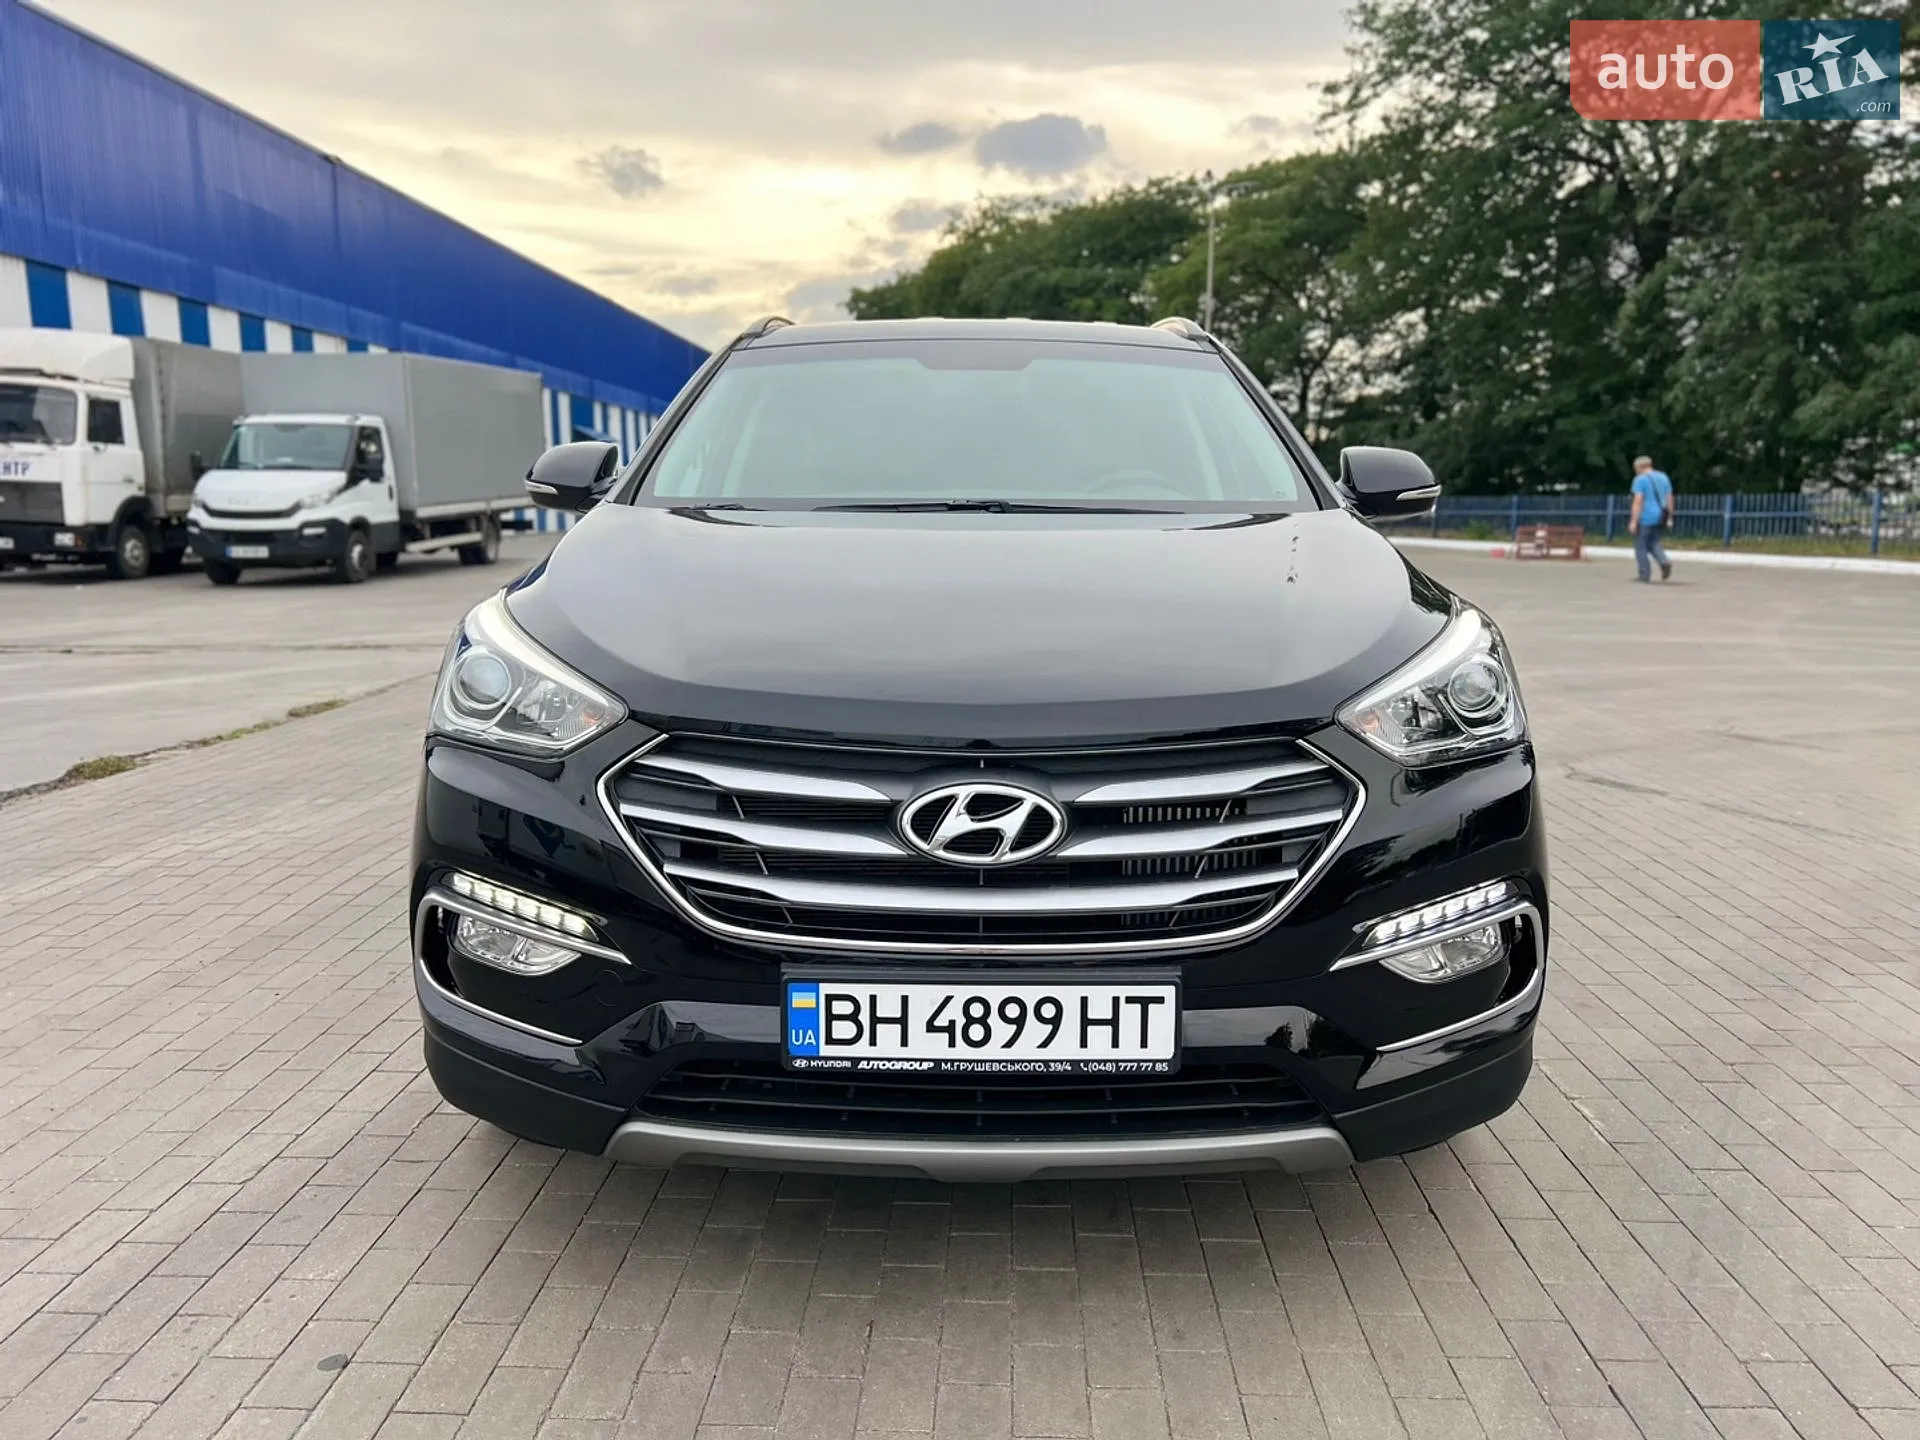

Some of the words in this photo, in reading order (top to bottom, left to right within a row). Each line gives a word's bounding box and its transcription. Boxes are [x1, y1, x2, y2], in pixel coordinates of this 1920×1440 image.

[825, 994, 908, 1047] BH
[926, 995, 1063, 1049] 4899
[1080, 996, 1165, 1049] HT
[792, 1030, 816, 1045] UA
[810, 1060, 852, 1068] HYUNDAI
[857, 1060, 935, 1070] AUTOGROUP
[1049, 1062, 1072, 1072] 39/4
[1088, 1062, 1116, 1073] (048)
[1118, 1062, 1138, 1072] 777
[1140, 1062, 1153, 1072] 77
[1155, 1062, 1169, 1072] 85
